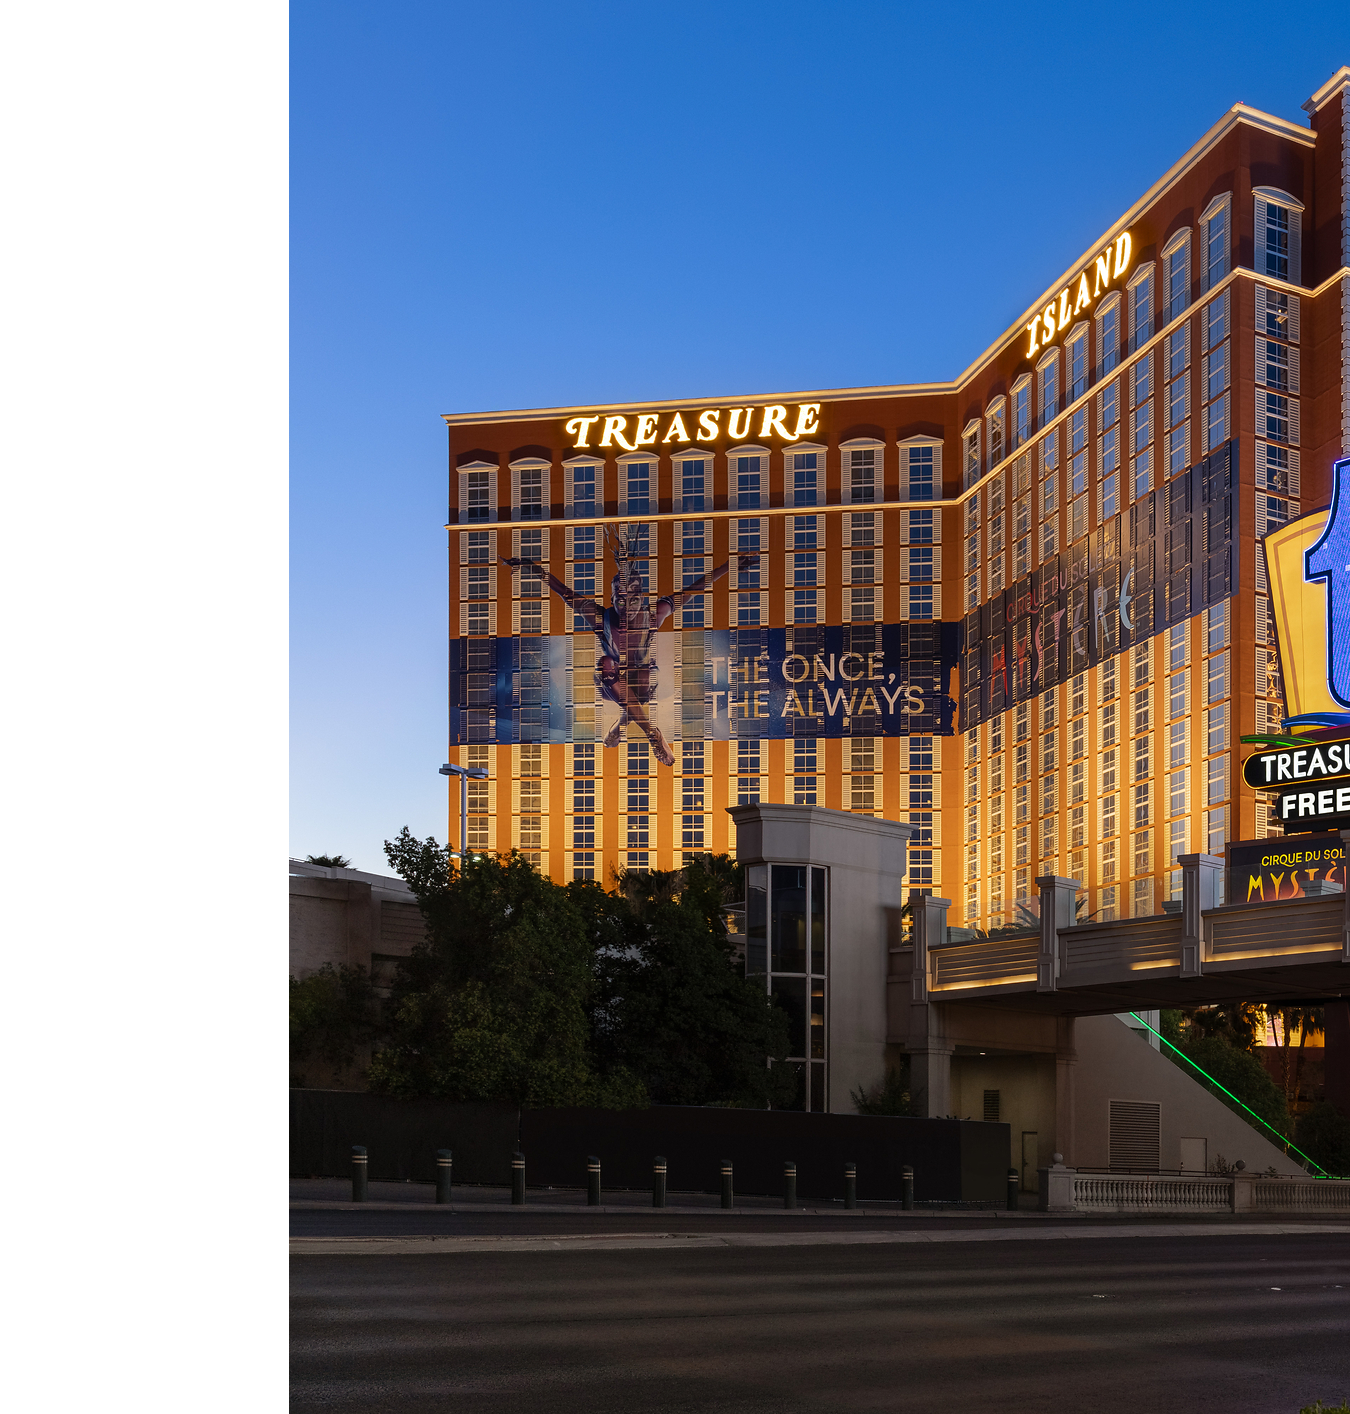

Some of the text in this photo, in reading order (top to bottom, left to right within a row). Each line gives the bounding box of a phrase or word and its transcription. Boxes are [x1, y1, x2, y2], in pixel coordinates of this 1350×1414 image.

[1025, 231, 1132, 359] ISLAND
[565, 403, 821, 451] TREASURE
[1006, 541, 1115, 623] CIRQUE DU SOLE
[706, 652, 896, 685] THE ONCE,
[706, 685, 925, 719] THE ALWAYS
[1261, 851, 1303, 868] CIRQUE
[1305, 850, 1321, 862] DU
